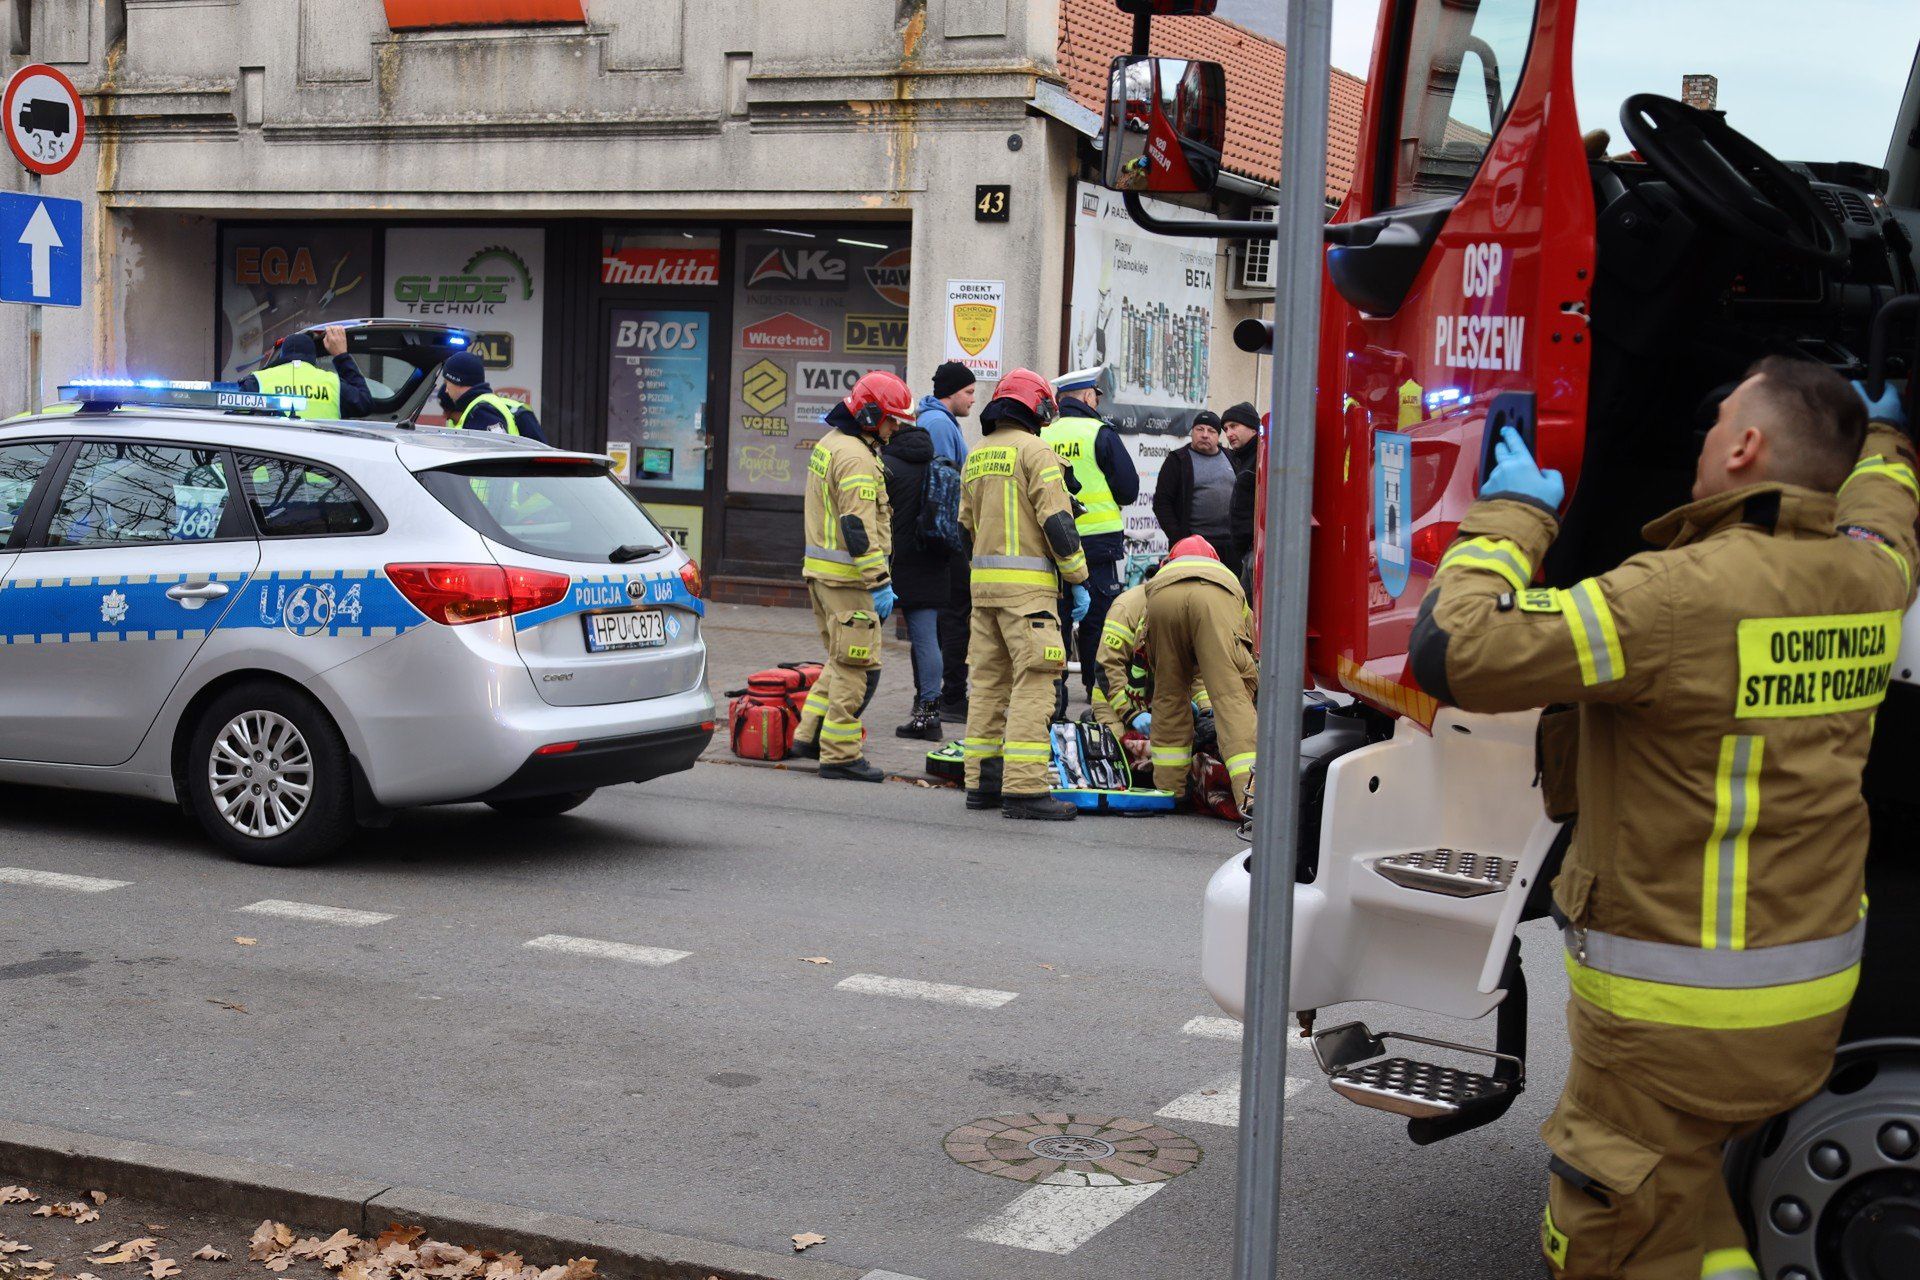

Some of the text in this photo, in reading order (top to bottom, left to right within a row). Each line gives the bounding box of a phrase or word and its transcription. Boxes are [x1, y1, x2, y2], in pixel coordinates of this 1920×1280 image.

[978, 191, 1005, 213] 43
[1114, 238, 1133, 256] Piany
[236, 246, 318, 285] EGA
[797, 249, 846, 280] K2
[1116, 258, 1149, 275] pianokleje
[1462, 242, 1503, 298] OSP
[394, 275, 510, 303] GUIDE
[960, 285, 993, 293] OBIEKT
[1185, 267, 1212, 290] BETA
[949, 292, 1002, 301] CHRONIONY
[407, 303, 495, 314] TECHNIK
[956, 306, 993, 314] OCHRONA
[616, 320, 700, 352] BROS
[748, 332, 825, 348] Wkręt-met
[1434, 314, 1525, 372] PLESZEW
[802, 368, 861, 391] YATO
[220, 393, 265, 408] POLICJA
[274, 385, 329, 401] POLICJA
[741, 415, 788, 430] VOREL
[259, 582, 363, 625] U684
[575, 586, 622, 606] POLICJA
[595, 613, 662, 643] HPU C873
[1105, 635, 1120, 646] PSP
[1771, 624, 1886, 664] OCHOTNICZA
